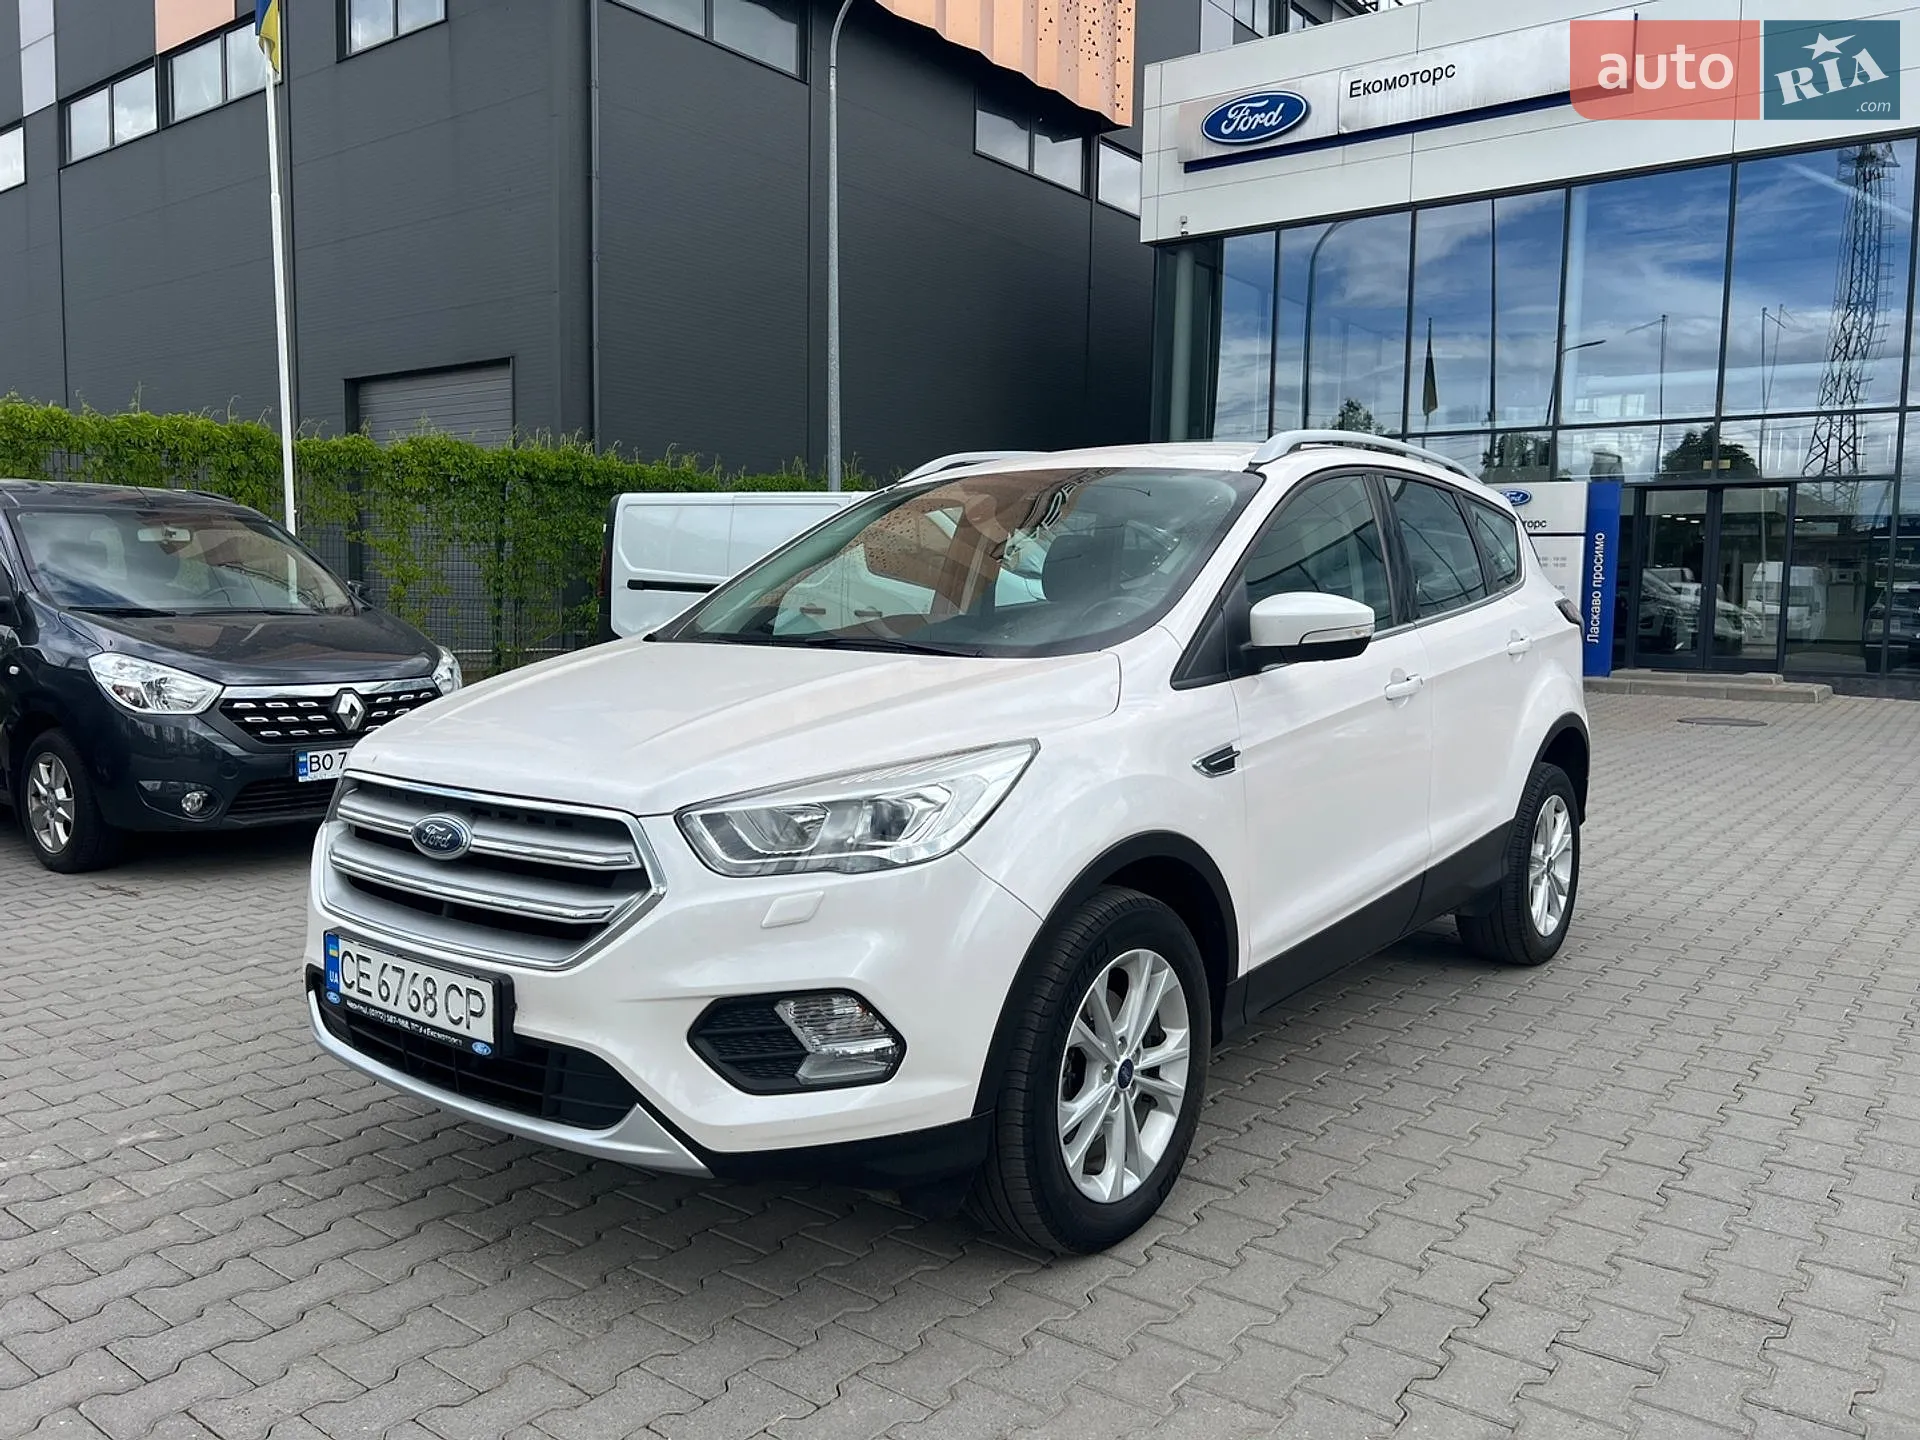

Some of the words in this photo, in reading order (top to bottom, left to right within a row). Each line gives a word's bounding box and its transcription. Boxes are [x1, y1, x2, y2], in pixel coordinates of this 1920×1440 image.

[1349, 63, 1456, 98] Екомоторс
[1221, 99, 1285, 135] Ford
[1592, 532, 1605, 588] просимо
[1587, 590, 1602, 644] Ласкаво
[310, 753, 334, 773] BO
[421, 824, 453, 849] Ford
[329, 970, 339, 984] UA
[341, 950, 373, 998] CE
[378, 962, 438, 1018] 6768
[444, 983, 487, 1030] CP
